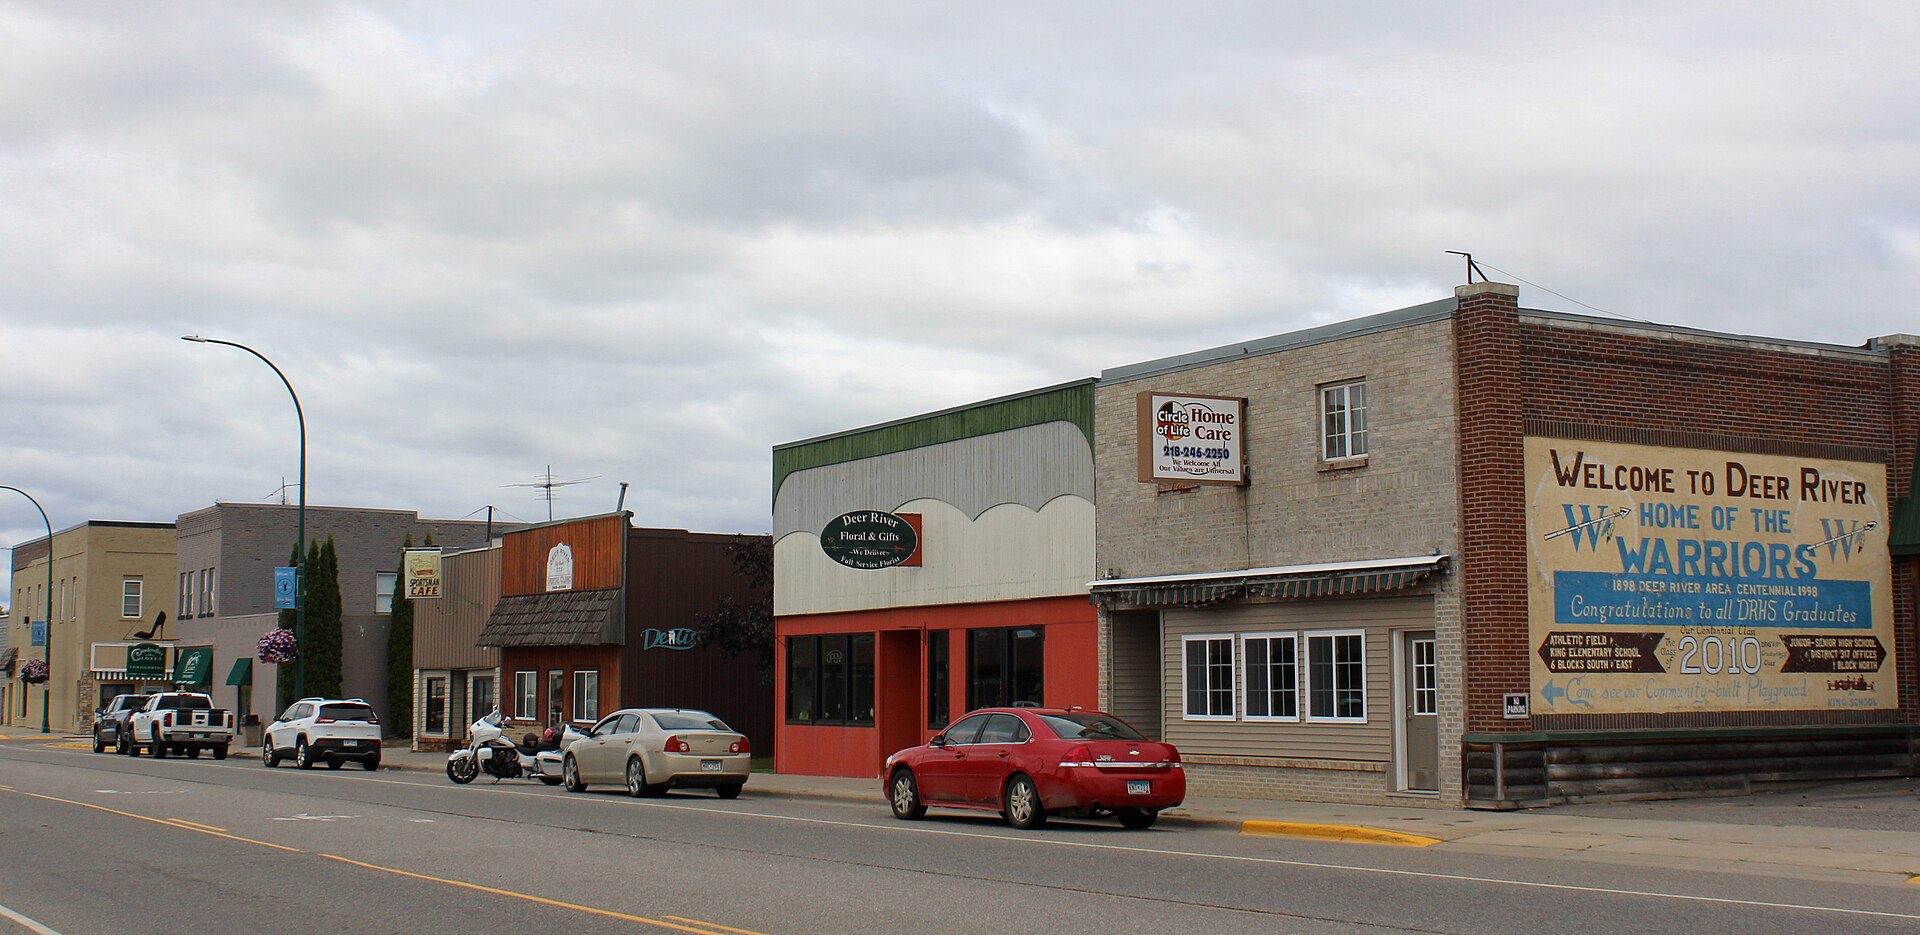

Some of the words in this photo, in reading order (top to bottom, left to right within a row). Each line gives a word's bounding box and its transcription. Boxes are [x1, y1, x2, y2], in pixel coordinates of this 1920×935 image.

[1158, 410, 1188, 423] Circle
[1191, 408, 1234, 424] Home
[1157, 425, 1168, 435] of
[1170, 426, 1190, 437] Life
[1194, 426, 1231, 440] Care
[1163, 446, 1230, 460] 218-246-2250
[842, 514, 868, 526] Deer
[870, 512, 899, 528] River
[1640, 502, 1700, 529] HOME
[1712, 506, 1738, 531] OF
[1750, 508, 1792, 534] THE
[840, 532, 866, 541] Floral
[868, 532, 876, 541] &
[878, 532, 900, 541] Gifts
[840, 556, 854, 566] Full
[880, 556, 900, 567] Florist
[1616, 536, 1816, 579] WARRIORS
[410, 578, 440, 587] SPORTSMAN
[411, 587, 438, 595] CAFE
[1612, 580, 1636, 592] 1898
[1638, 580, 1666, 593] DEER
[1670, 582, 1700, 594] RIVER
[1705, 583, 1732, 594] AREA
[1736, 584, 1796, 597] CENTENNIAL
[1798, 586, 1818, 598] 1998
[1571, 594, 1692, 624] Congratulations
[1699, 602, 1712, 619] to
[1716, 598, 1732, 620] all
[1737, 598, 1778, 621] DRHS
[1783, 600, 1857, 622] Graduates
[1680, 624, 1694, 634] Our
[1696, 624, 1734, 634] Centennial
[1738, 624, 1756, 636] Class
[1550, 635, 1582, 645] ATHLETIC
[1586, 636, 1606, 645] FIELD
[1790, 638, 1836, 648] JUNIOR-SENIOR
[1838, 639, 1853, 648] HIGH
[1854, 638, 1877, 648] SCHOOL
[1550, 648, 1567, 657] KING
[1568, 648, 1612, 658] ELEMENTARY
[1614, 648, 1641, 658] SCHOOL
[1678, 636, 1761, 675] 2010
[1810, 650, 1838, 660] DISTRICT
[1852, 650, 1877, 660] OFFICES
[1550, 660, 1556, 670] 6
[1558, 660, 1584, 670] BLOCKS
[1586, 660, 1609, 670] SOUTH
[1616, 660, 1633, 670] EAST
[1837, 660, 1857, 670] BLOCK
[1858, 661, 1878, 670] NORTH
[1566, 678, 1595, 708] Come
[1602, 687, 1620, 698] see
[1624, 687, 1641, 698] our
[1745, 675, 1807, 705] Playground
[1513, 696, 1520, 705] NO
[1848, 698, 1878, 707] SCHOOL
[1508, 705, 1526, 714] PARKING
